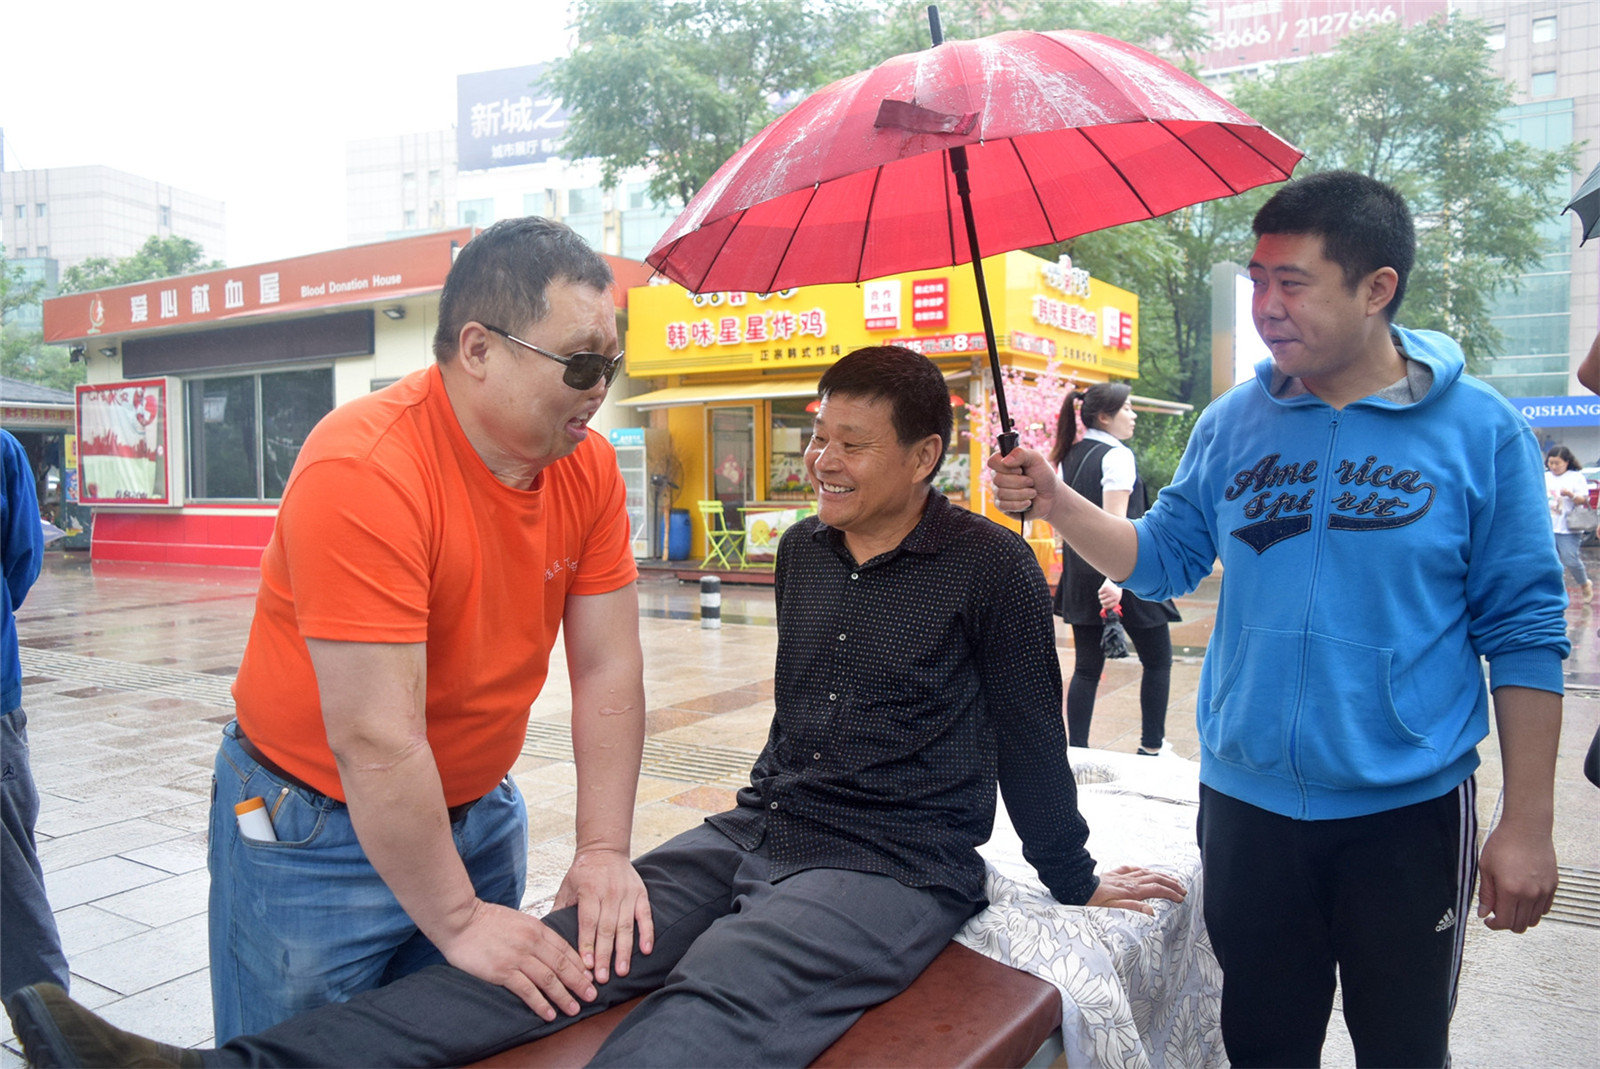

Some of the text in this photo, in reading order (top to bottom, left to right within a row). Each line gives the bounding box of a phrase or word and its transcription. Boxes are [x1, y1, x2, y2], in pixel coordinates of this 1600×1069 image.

[1294, 5, 1397, 38] 2127666
[130, 271, 281, 323] 爱心献血屋
[300, 273, 402, 298] Blood Donation House
[665, 308, 827, 350] 韩味星星炸鸡
[760, 344, 842, 362] 正宗韩式炸鸡
[1521, 403, 1600, 419] QISHANG
